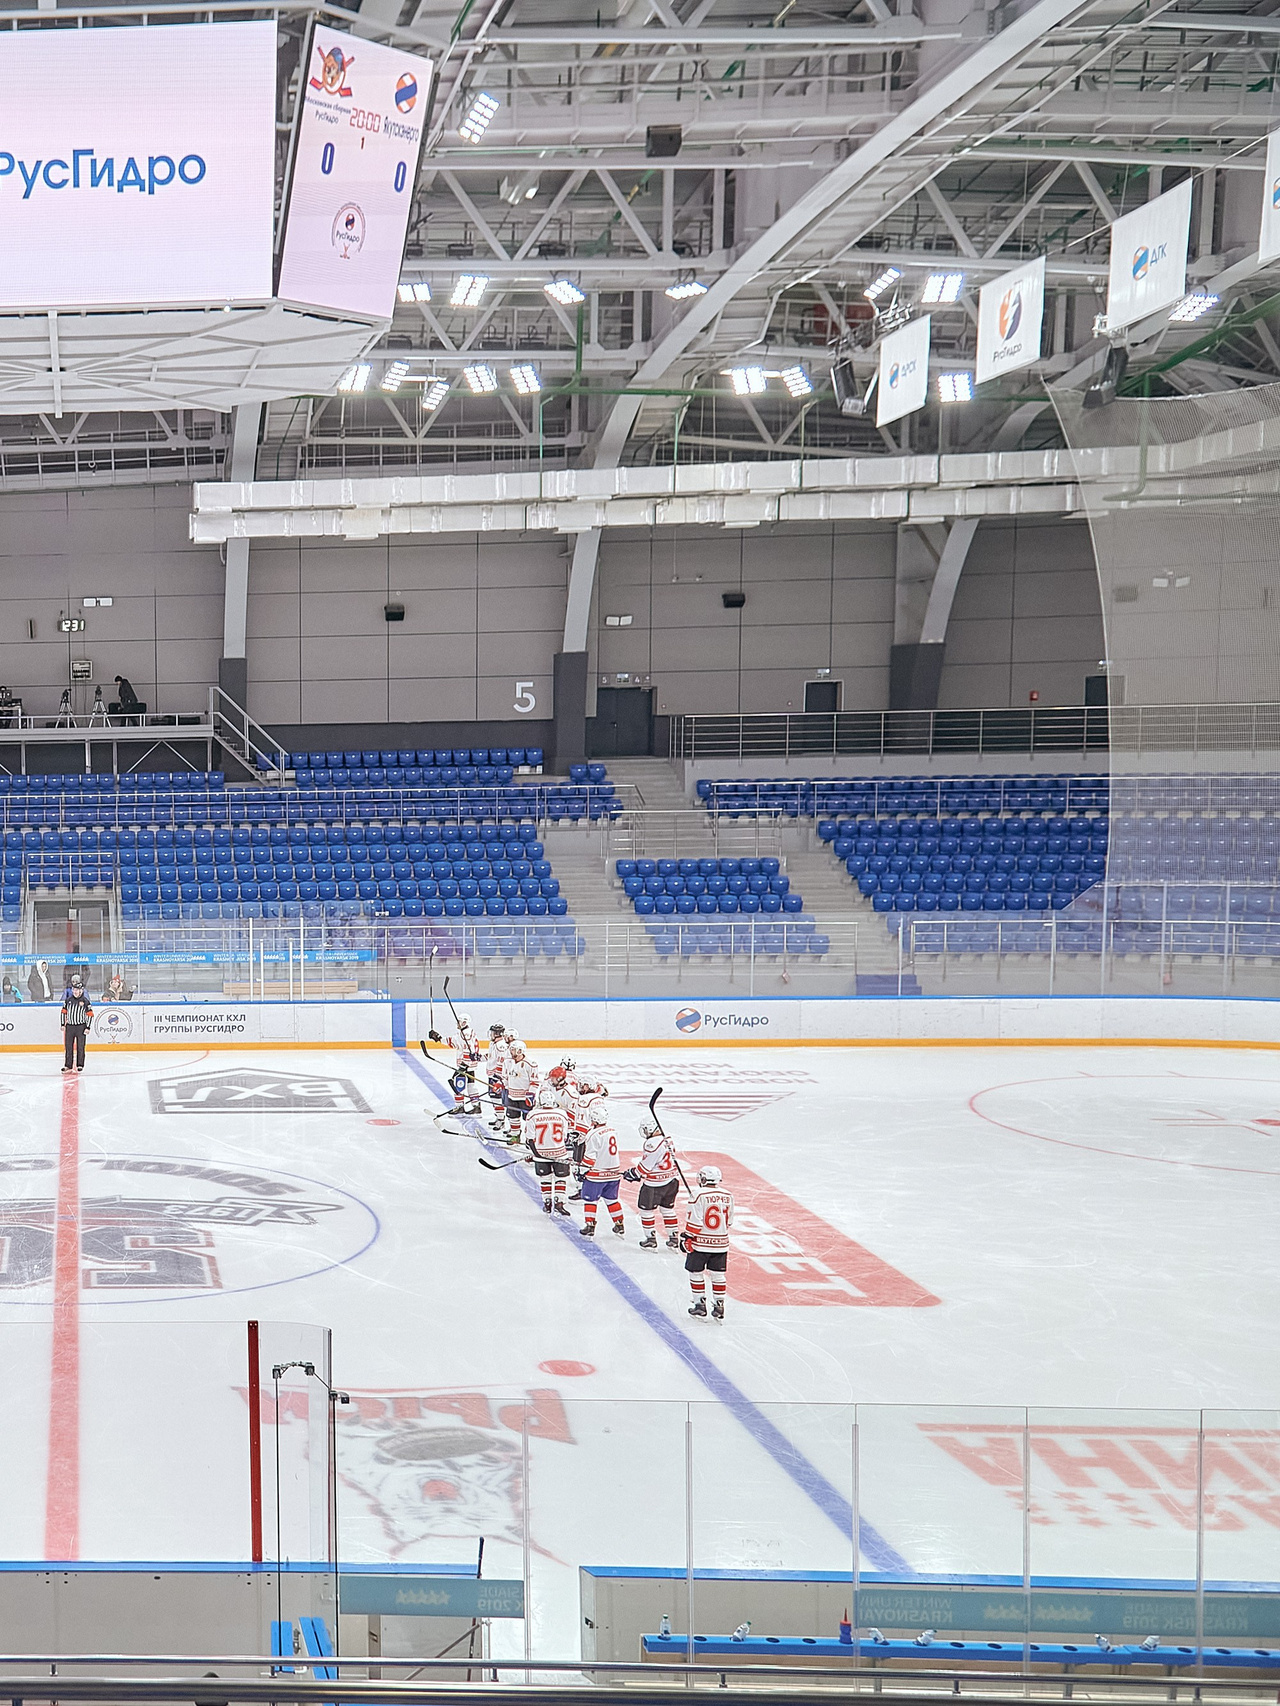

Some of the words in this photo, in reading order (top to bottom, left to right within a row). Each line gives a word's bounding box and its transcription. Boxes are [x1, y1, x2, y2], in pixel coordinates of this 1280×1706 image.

[315, 110, 339, 124] РусГидро
[349, 107, 381, 133] 20:00
[360, 136, 365, 150] 1
[321, 142, 335, 175] 0
[393, 161, 407, 193] 0
[513, 681, 536, 713] 5
[153, 1015, 163, 1023] III
[165, 1014, 224, 1023] ЧЕМПИОНАТ
[226, 1014, 246, 1022] КХЛ
[704, 1014, 770, 1028] РусГидро
[99, 1026, 127, 1034] РусГидро
[154, 1025, 193, 1034] ГРУППЫ
[195, 1025, 245, 1034] РУСГИДРО
[161, 1080, 348, 1103] ВХЛ
[535, 1122, 564, 1145] 75
[608, 1135, 618, 1156] 8
[162, 1205, 253, 1219] 1973
[704, 1205, 730, 1230] 61
